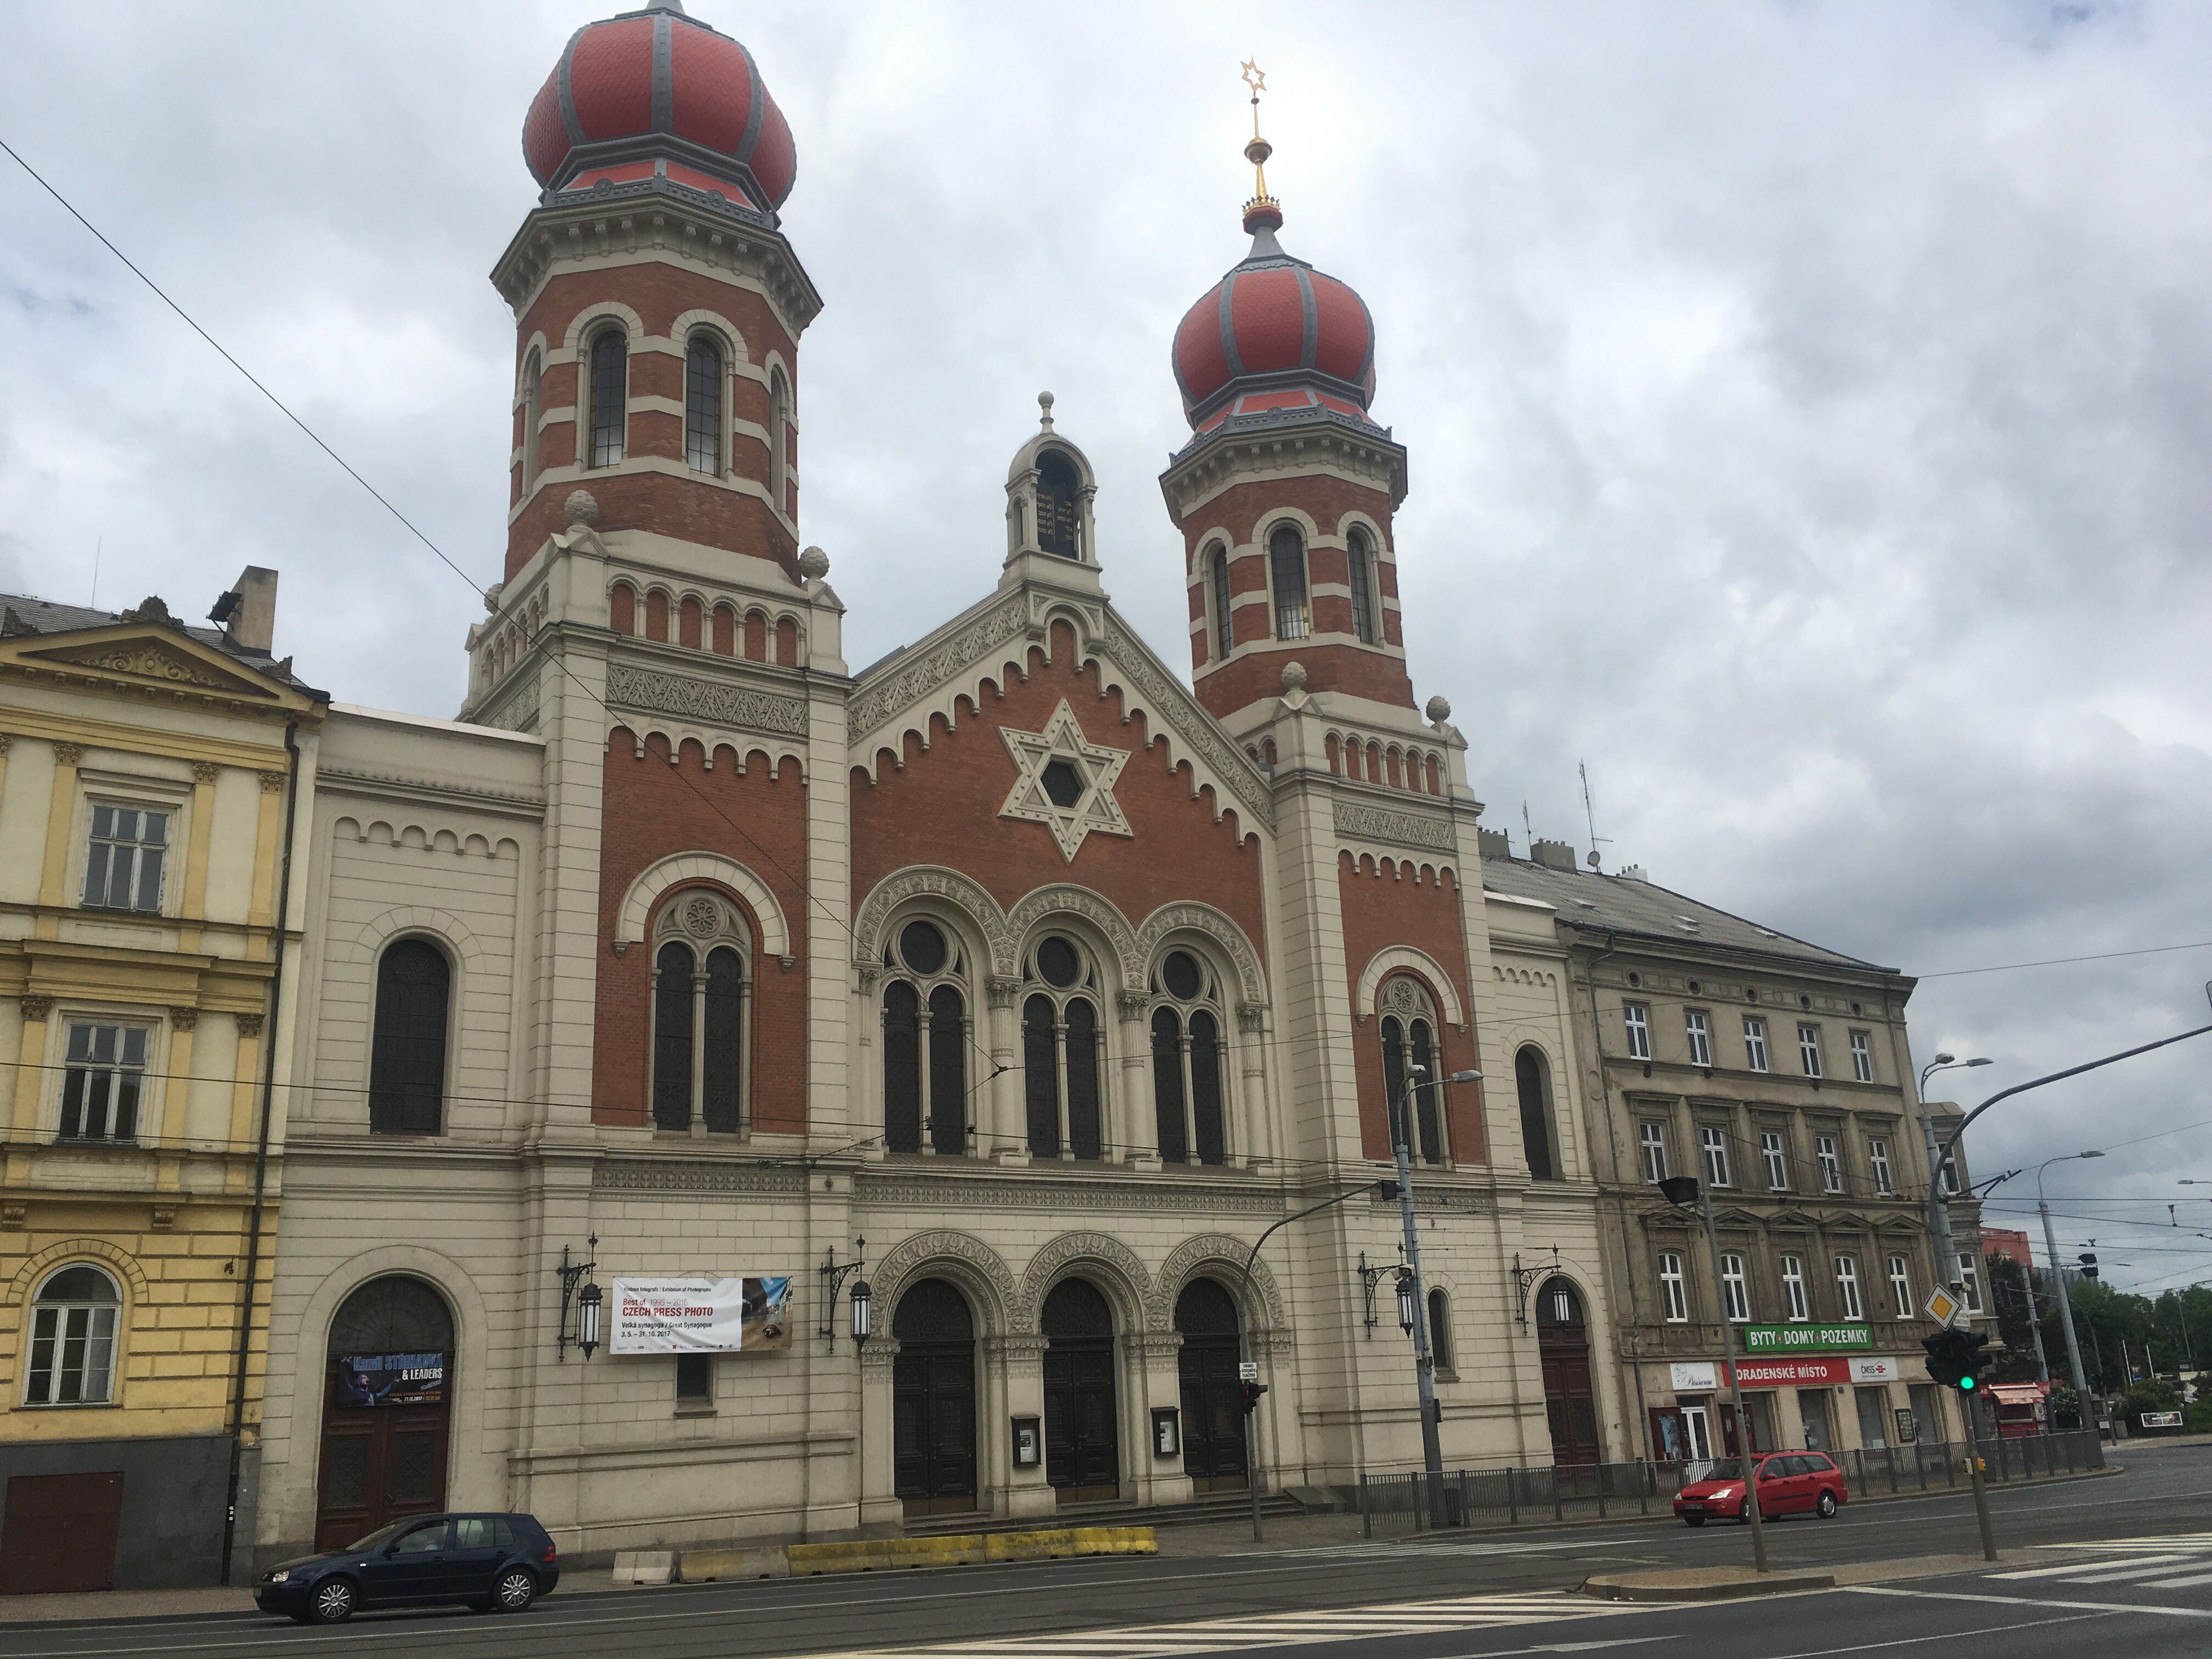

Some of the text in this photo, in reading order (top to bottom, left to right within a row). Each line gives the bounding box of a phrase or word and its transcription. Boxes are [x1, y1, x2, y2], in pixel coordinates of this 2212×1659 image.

[623, 1307, 713, 1317] CZECH PRESS PHOTO
[1750, 1329, 1867, 1346] BYTY DOMY POZEMKY
[353, 1356, 382, 1371] Kamil
[402, 1368, 442, 1380] & LEADERS
[1737, 1364, 1827, 1380] ORADENSKÉ MÍSTO
